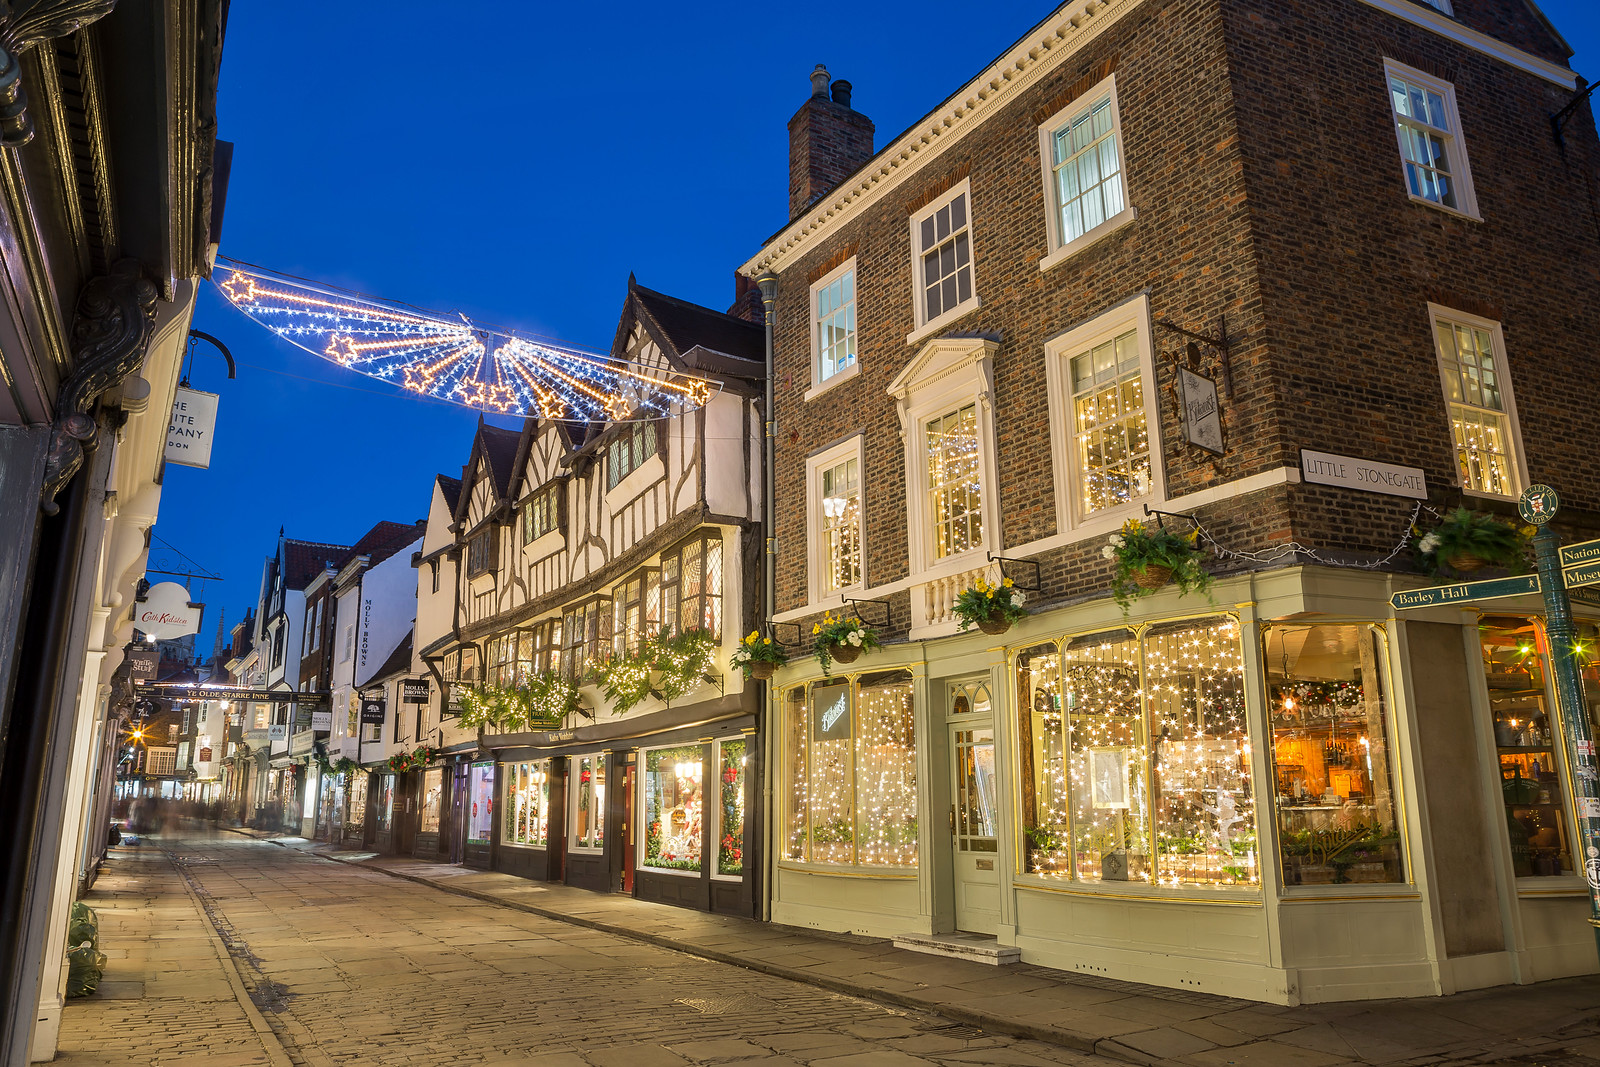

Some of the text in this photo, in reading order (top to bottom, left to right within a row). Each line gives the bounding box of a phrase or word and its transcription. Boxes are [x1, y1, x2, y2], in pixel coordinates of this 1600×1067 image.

[173, 401, 187, 411] HE
[174, 413, 194, 425] ITE
[168, 425, 204, 439] PANY
[168, 441, 189, 449] DON
[1306, 458, 1423, 490] LITTLE STONEGATE
[1399, 586, 1469, 604] Barley Hall
[142, 611, 188, 624] Cath Kidston
[364, 599, 372, 629] MOLLY
[361, 631, 369, 667] BROWNS
[187, 689, 270, 700] YE OLDE STARRE INNE
